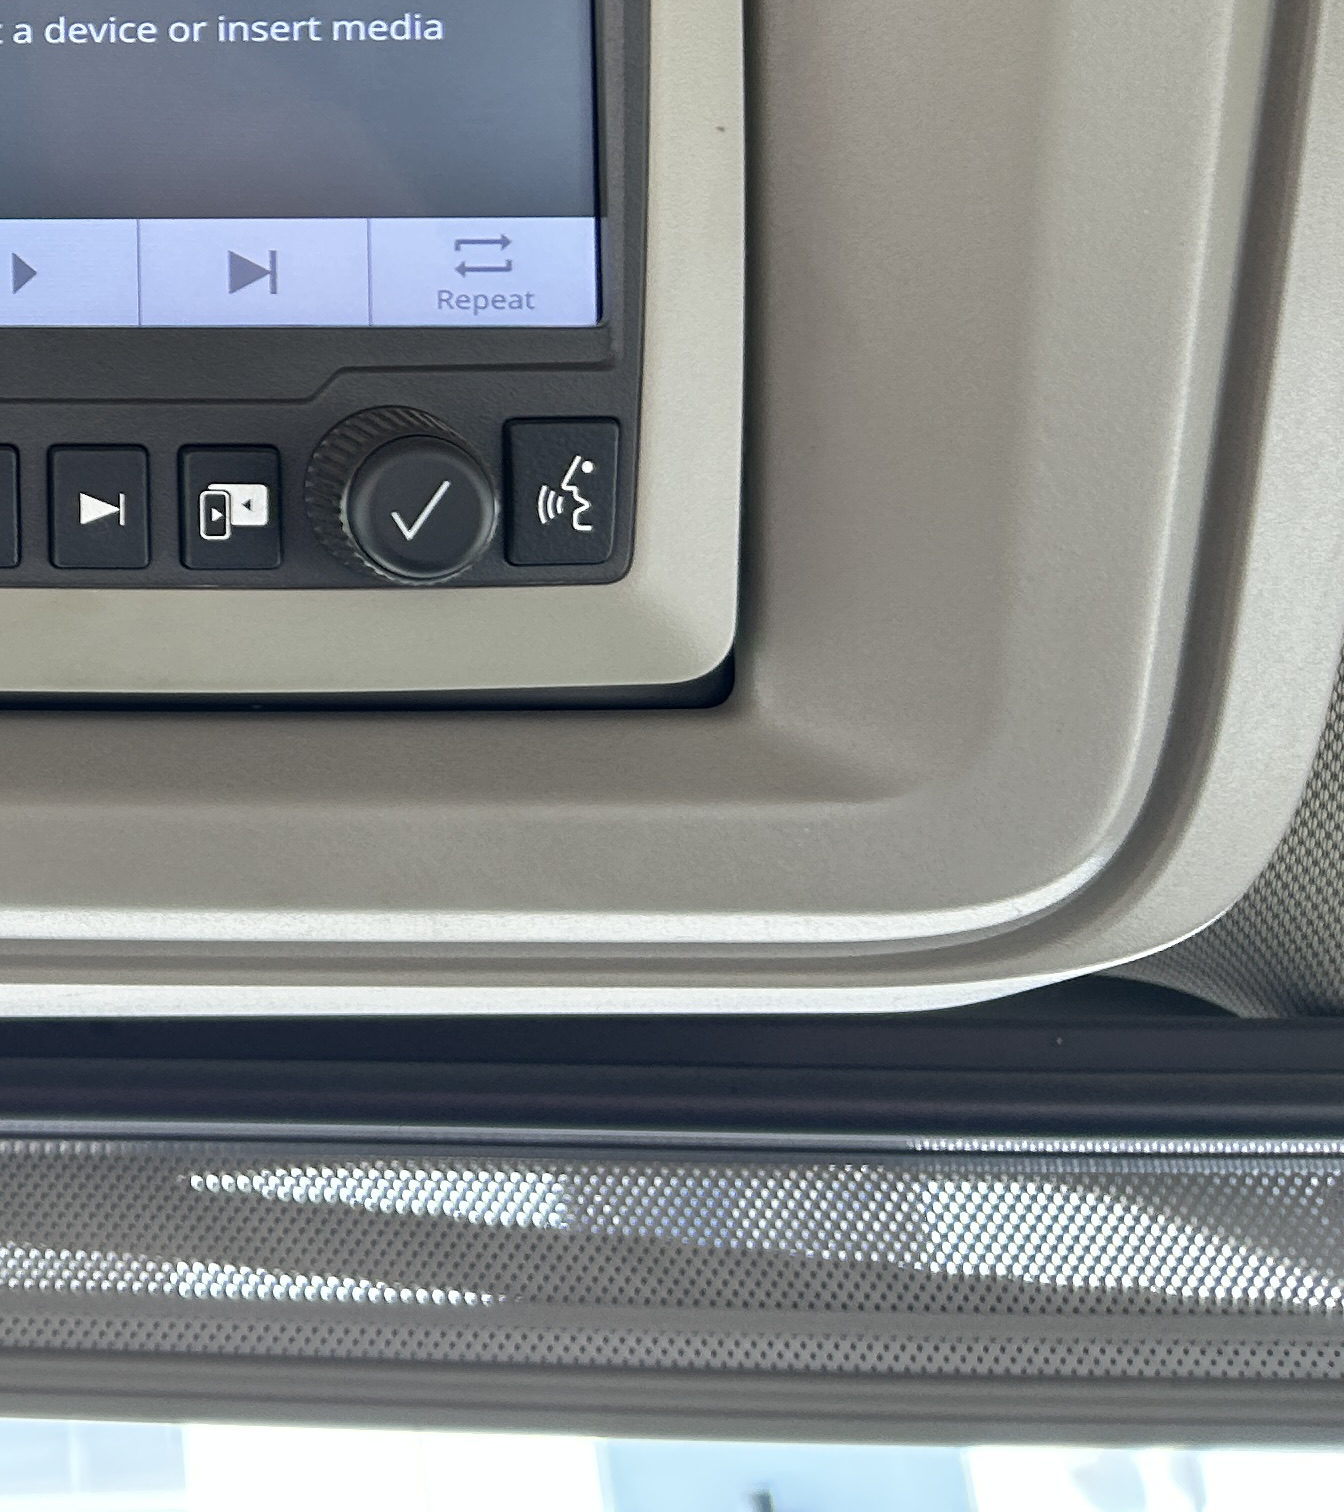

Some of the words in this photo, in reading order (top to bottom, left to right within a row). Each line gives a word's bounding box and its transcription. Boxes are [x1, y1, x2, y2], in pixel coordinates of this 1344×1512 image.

[14, 25, 34, 45] a
[45, 17, 157, 45] device
[168, 21, 208, 43] or
[218, 16, 322, 43] insert
[332, 13, 444, 42] media
[436, 289, 536, 317] Repeat
